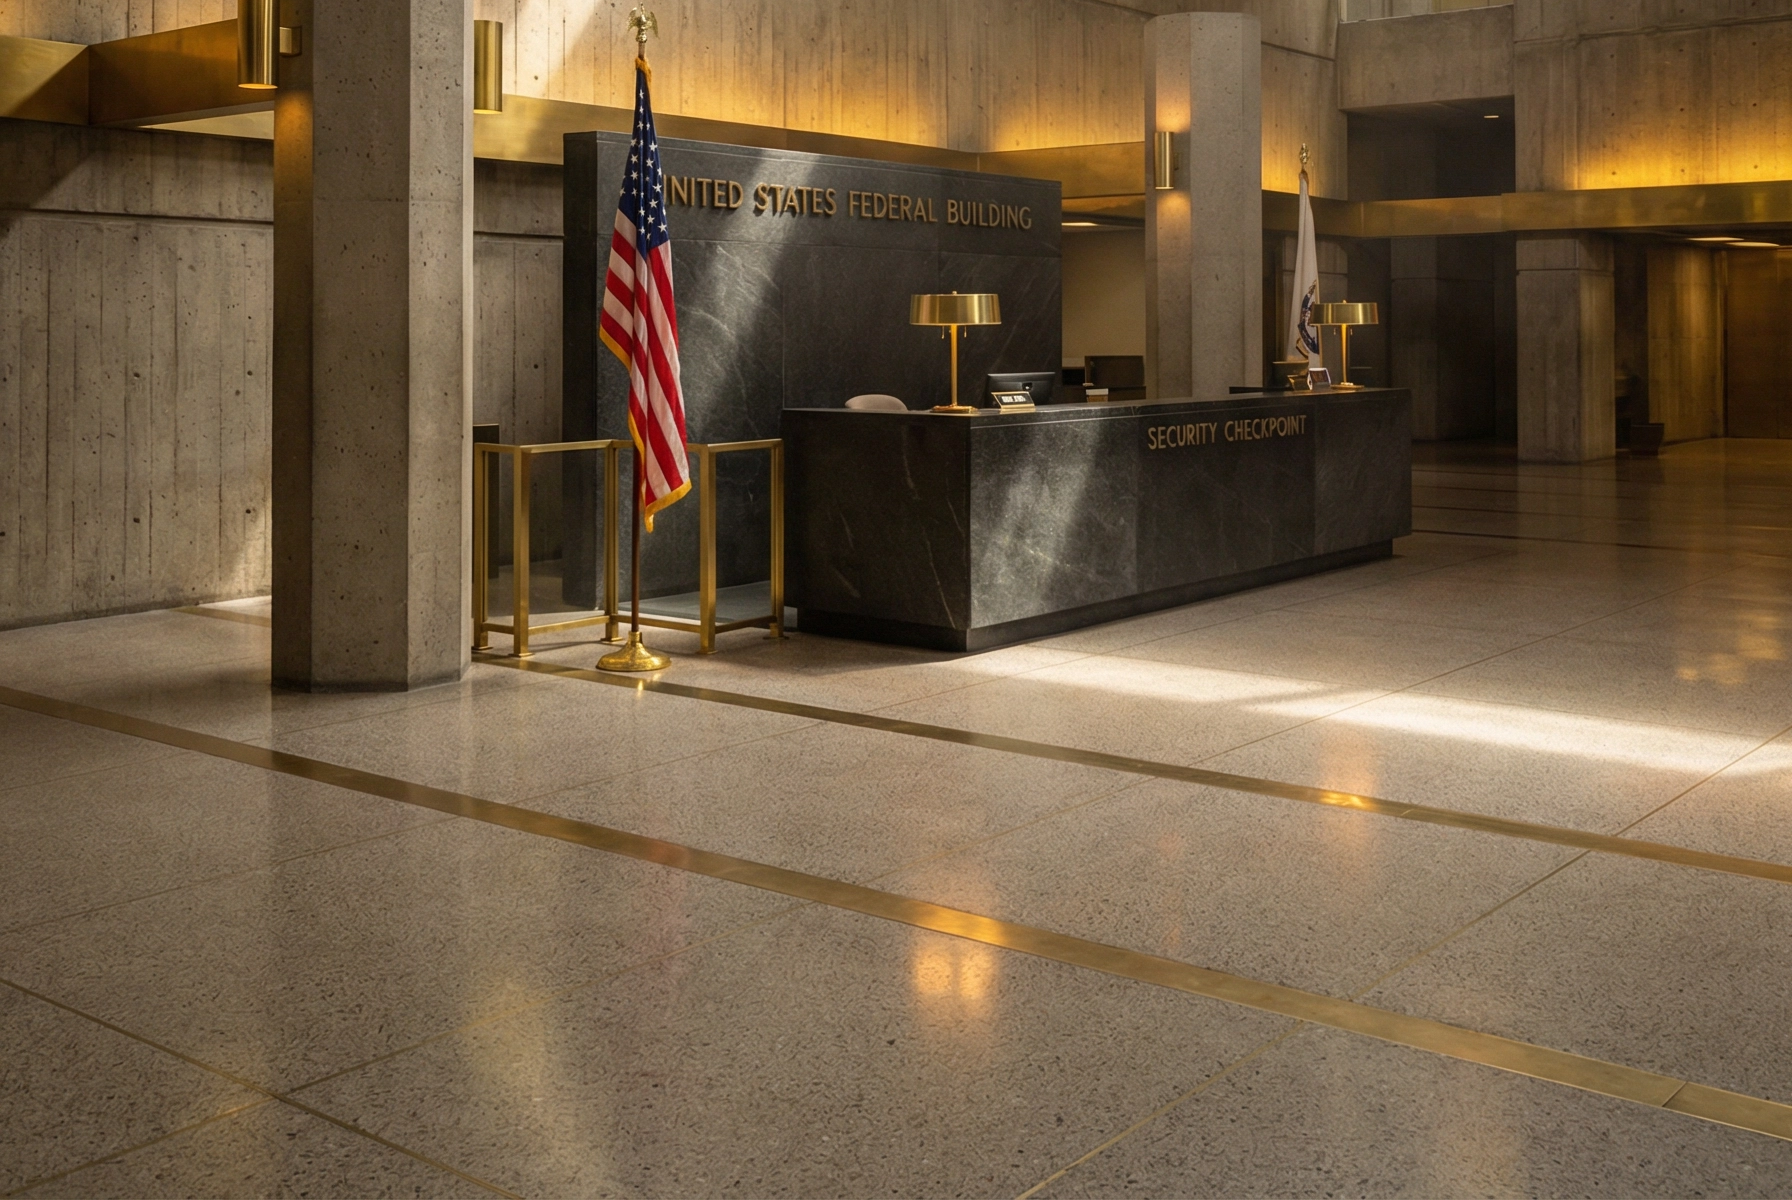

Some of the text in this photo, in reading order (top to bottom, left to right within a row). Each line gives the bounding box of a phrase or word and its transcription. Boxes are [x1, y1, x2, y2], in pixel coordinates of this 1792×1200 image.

[663, 174, 1032, 230] NITED STATES FEDERAL BUILDING
[1147, 415, 1307, 450] SECURITY CHECKPOINT
